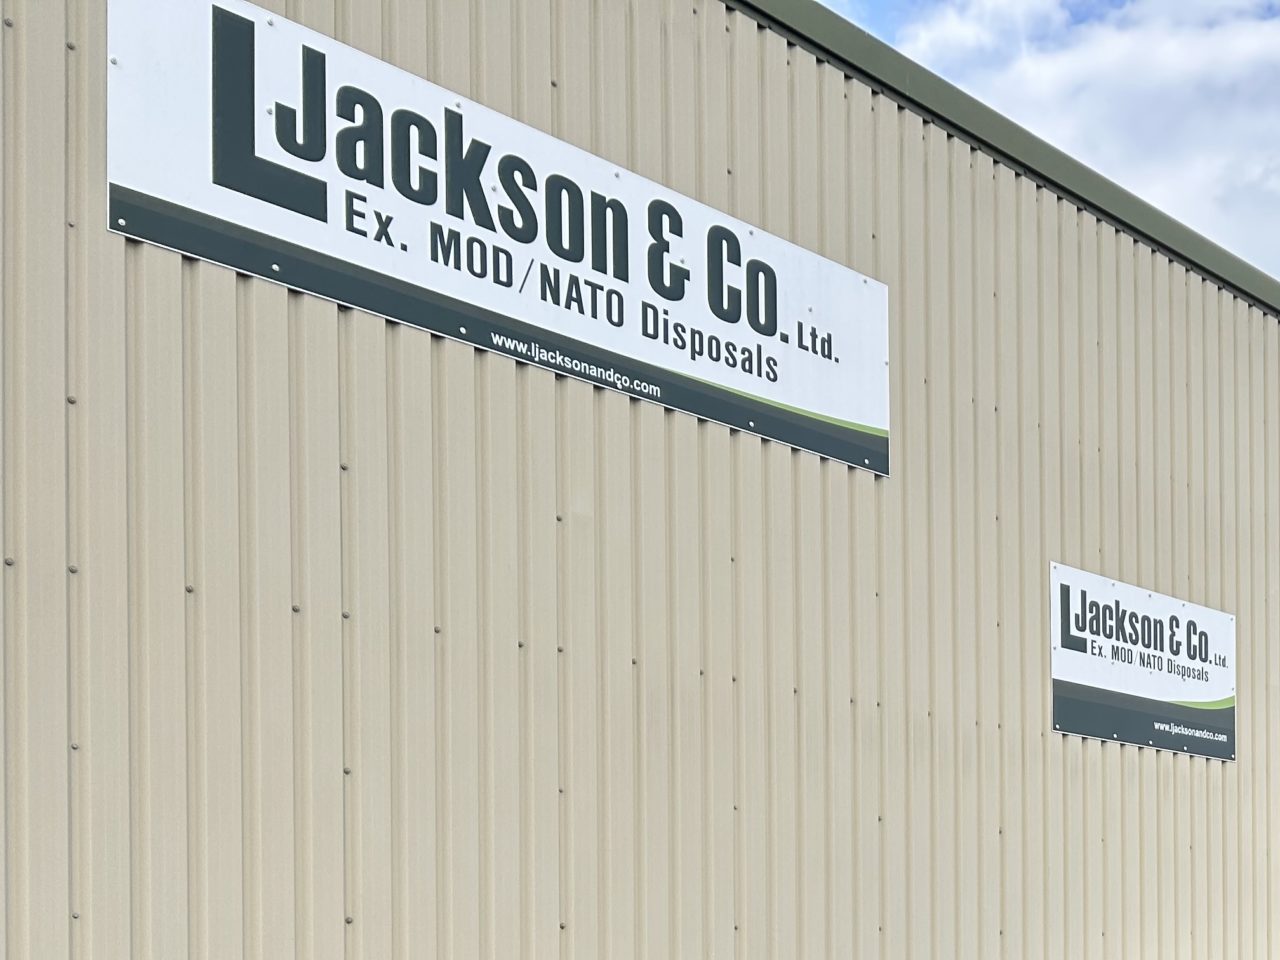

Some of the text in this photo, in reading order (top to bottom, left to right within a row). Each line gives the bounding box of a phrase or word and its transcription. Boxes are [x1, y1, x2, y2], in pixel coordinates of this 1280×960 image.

[345, 190, 779, 383] Ex. MOD/NATO Disposals
[647, 199, 690, 301] &
[707, 225, 789, 344] Co.
[797, 321, 840, 364] Ltd.
[490, 331, 661, 398] www.ljacksonandco.com
[1091, 640, 1107, 658] Ex.
[1167, 659, 1209, 682] Disposals
[1169, 615, 1182, 656] &
[1186, 620, 1213, 664] Co.
[1214, 653, 1229, 668] Ltd.
[1153, 721, 1228, 743] www.ljacksonandco.com
